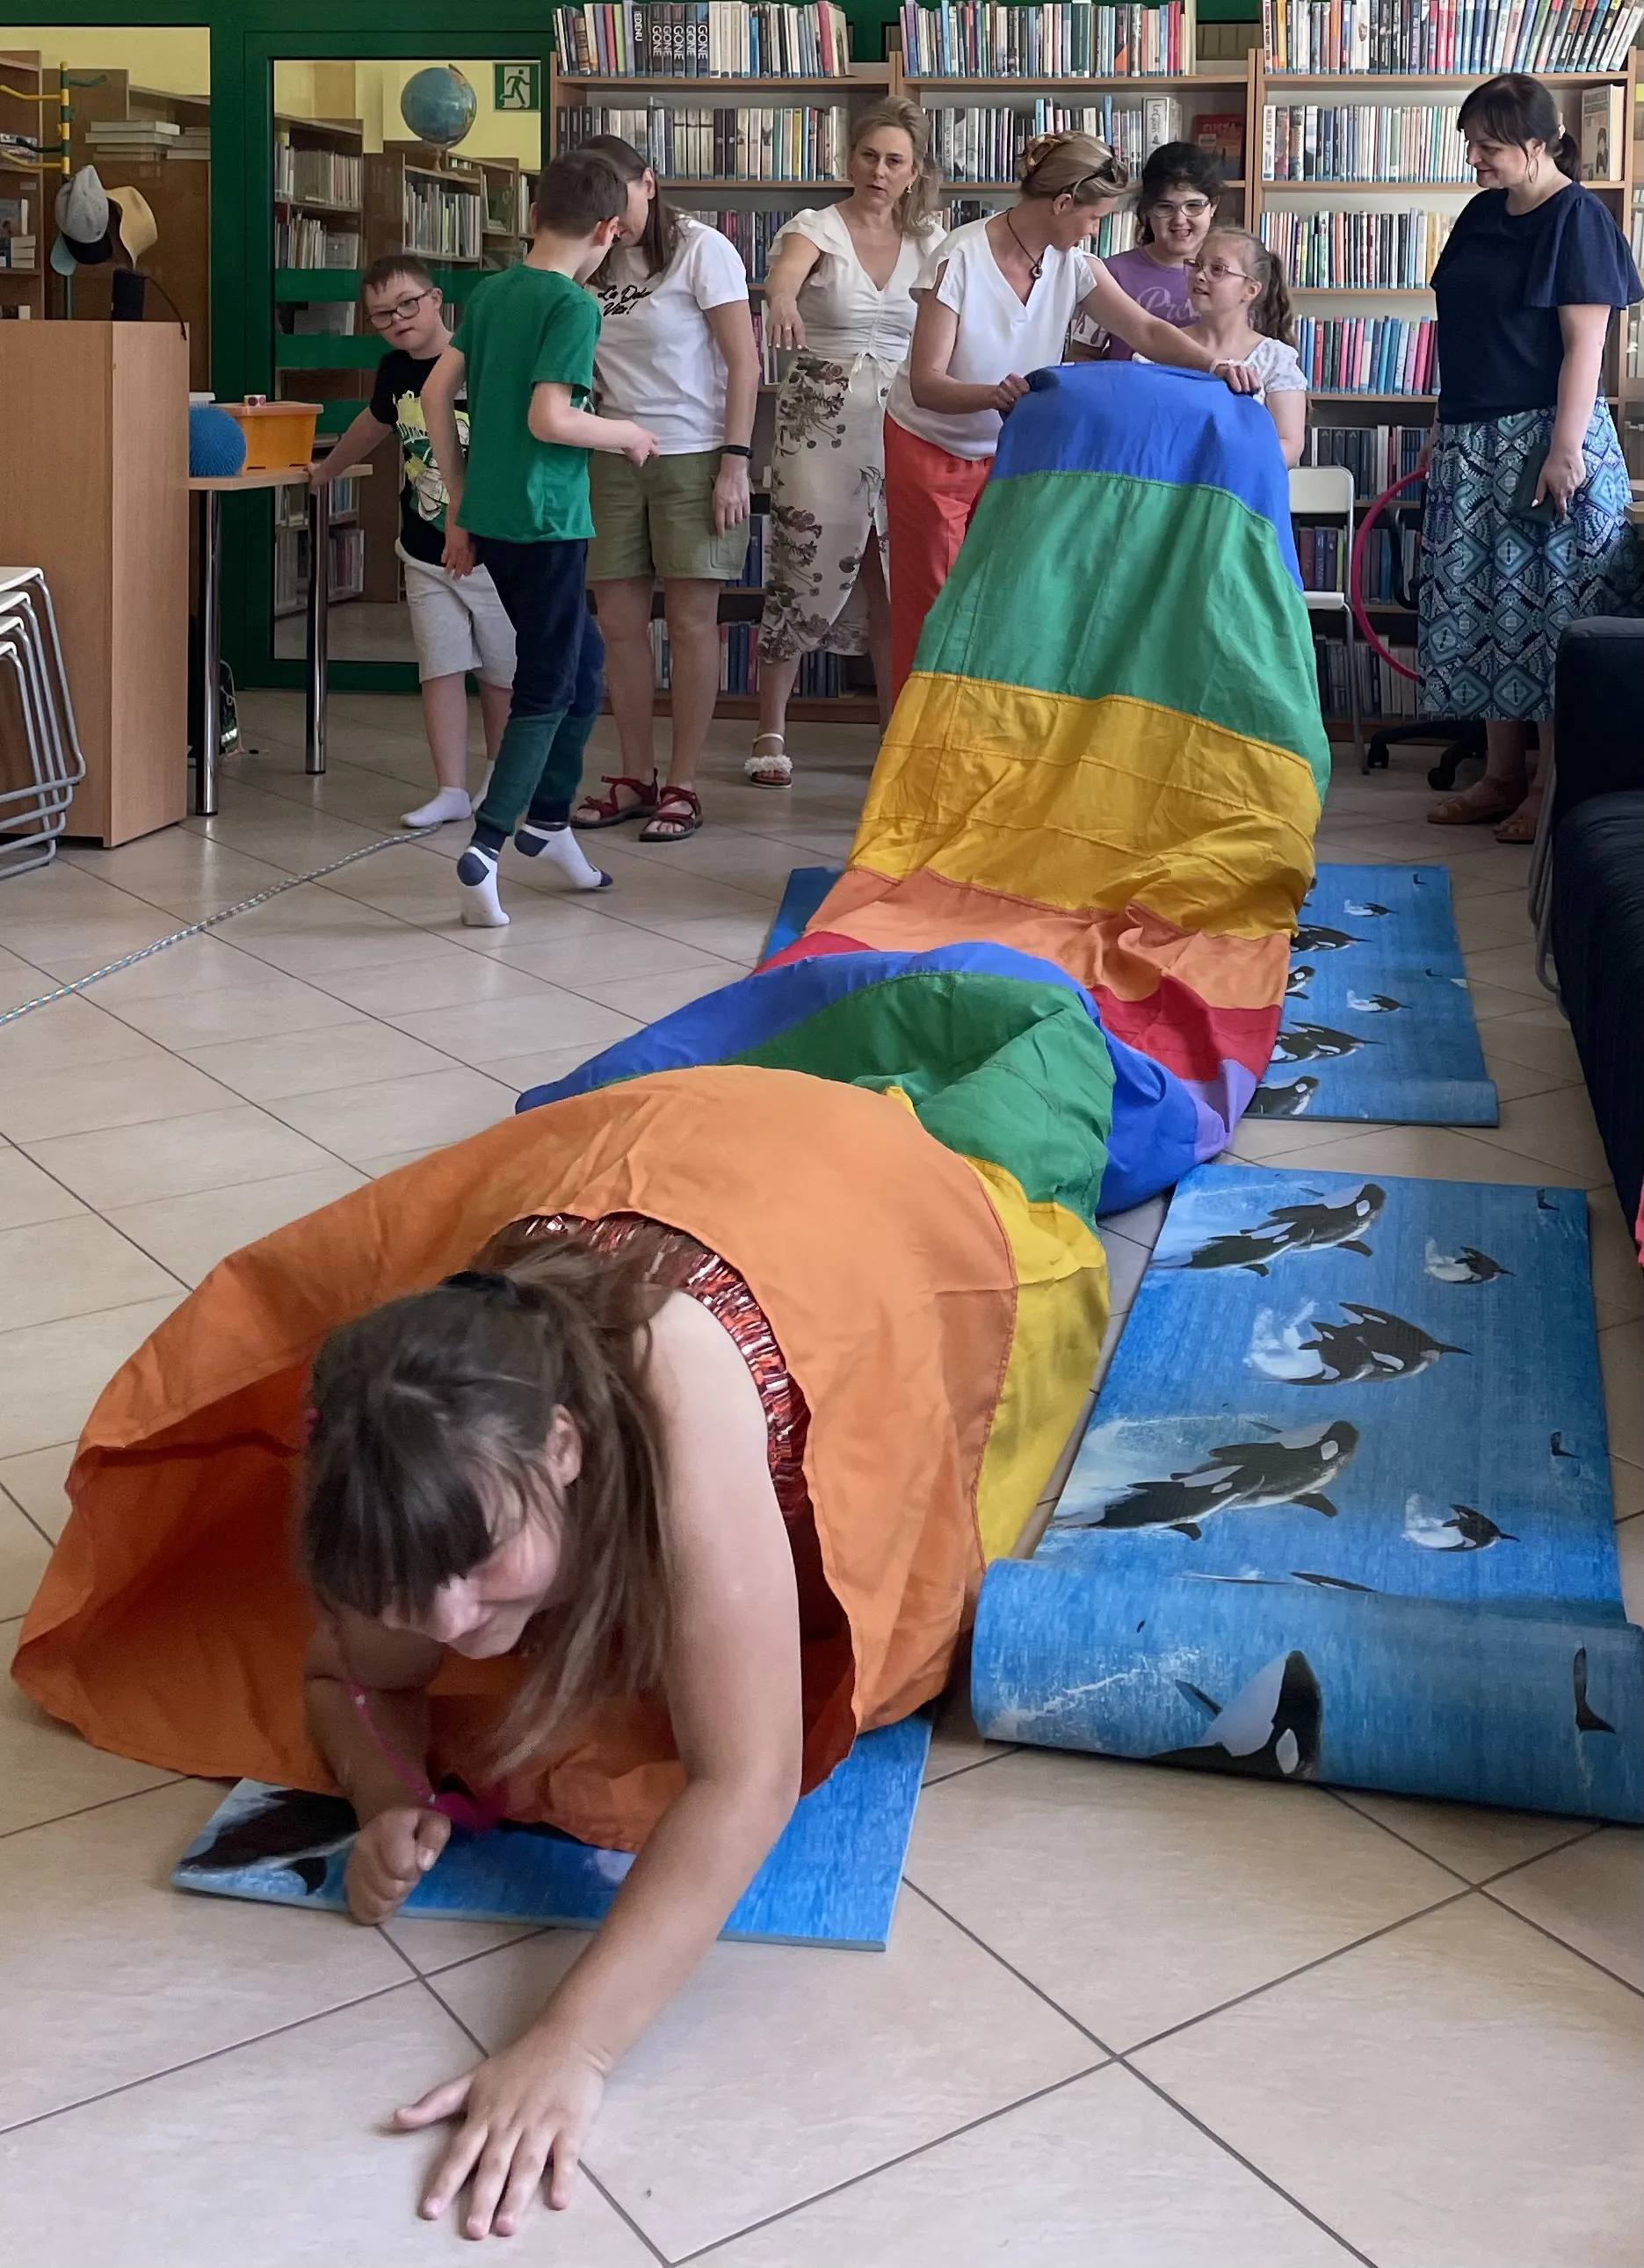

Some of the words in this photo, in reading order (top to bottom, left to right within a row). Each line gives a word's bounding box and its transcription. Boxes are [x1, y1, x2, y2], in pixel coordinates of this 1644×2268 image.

[652, 25, 663, 57] GONE
[663, 25, 672, 57] GONE
[673, 25, 684, 60] GONE
[686, 25, 696, 57] GONE
[698, 25, 708, 60] GONE
